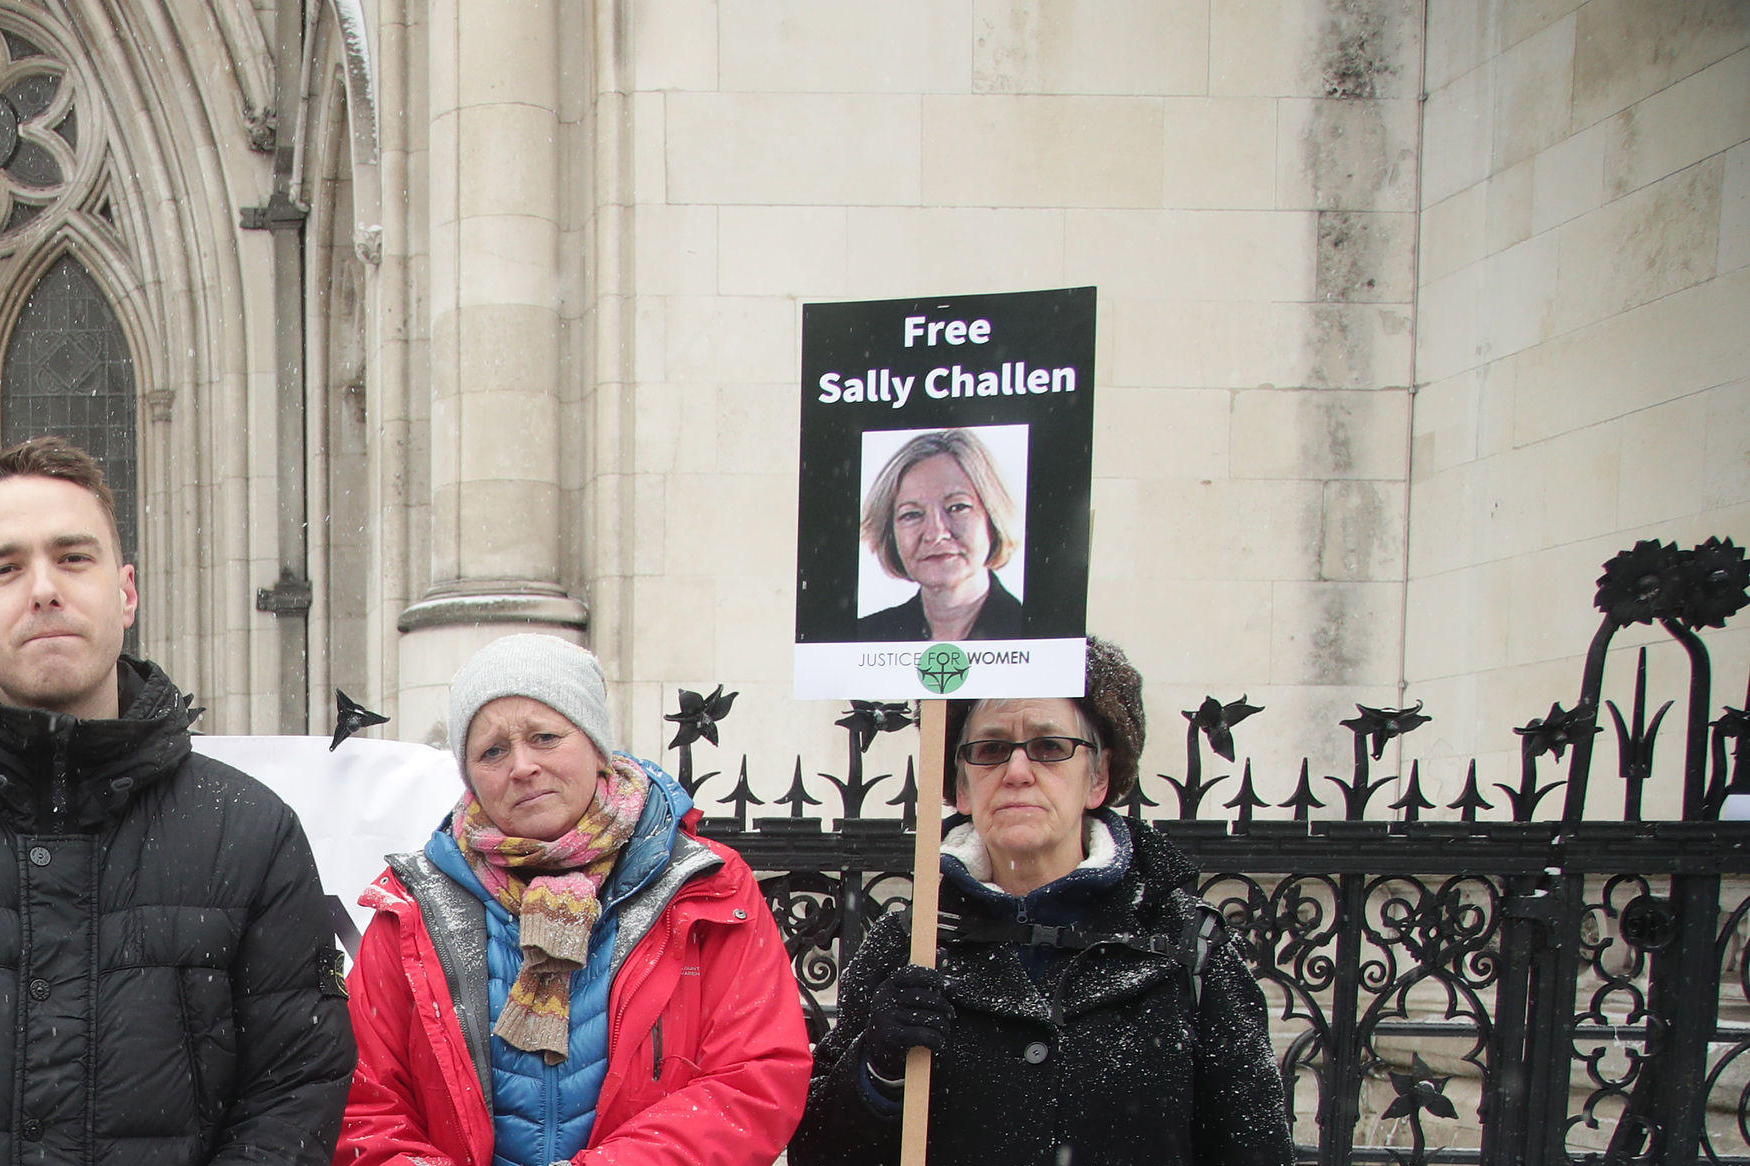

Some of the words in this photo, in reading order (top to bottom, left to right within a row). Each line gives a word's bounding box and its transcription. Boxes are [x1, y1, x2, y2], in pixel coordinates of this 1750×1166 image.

[904, 316, 991, 348] Free
[818, 369, 916, 409] Sally
[924, 361, 1076, 399] Challen
[858, 652, 922, 667] JUSTICE
[928, 652, 961, 666] FOR
[967, 651, 1030, 665] WOMEN
